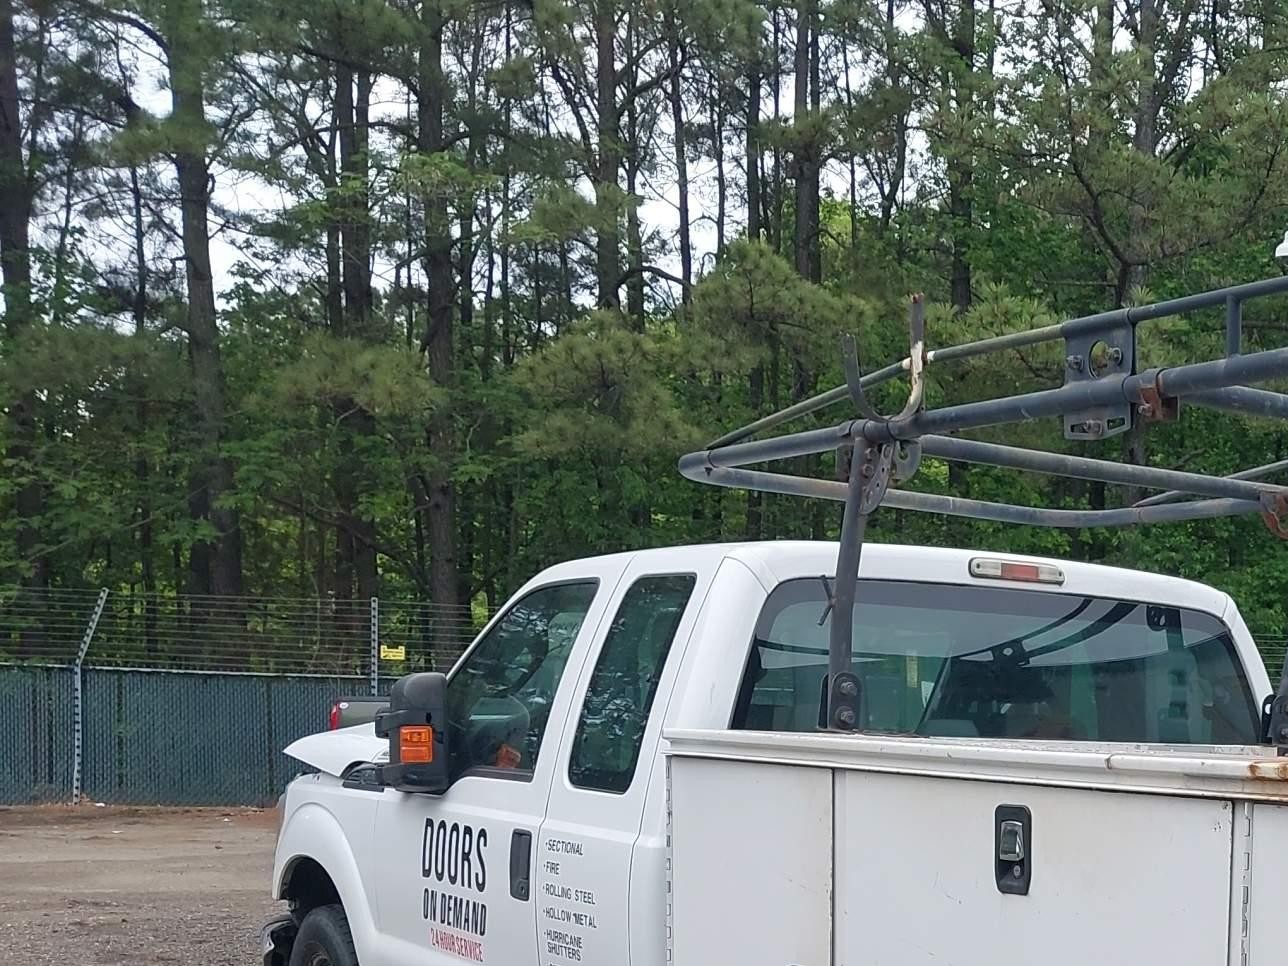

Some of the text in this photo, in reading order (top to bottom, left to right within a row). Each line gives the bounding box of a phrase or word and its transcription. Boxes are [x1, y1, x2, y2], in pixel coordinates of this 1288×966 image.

[422, 817, 488, 893] DOORS
[547, 839, 583, 856] SECTIONAL
[546, 861, 560, 875] FIRE
[545, 883, 595, 905] ROLLING STEEL
[423, 887, 487, 937] ON DEMAND
[545, 907, 597, 929] HOLLOW METAL
[430, 928, 483, 962] 24 HOUR SERVICE
[546, 929, 583, 949] HURRICANE
[547, 942, 581, 961] SHUTTERS
